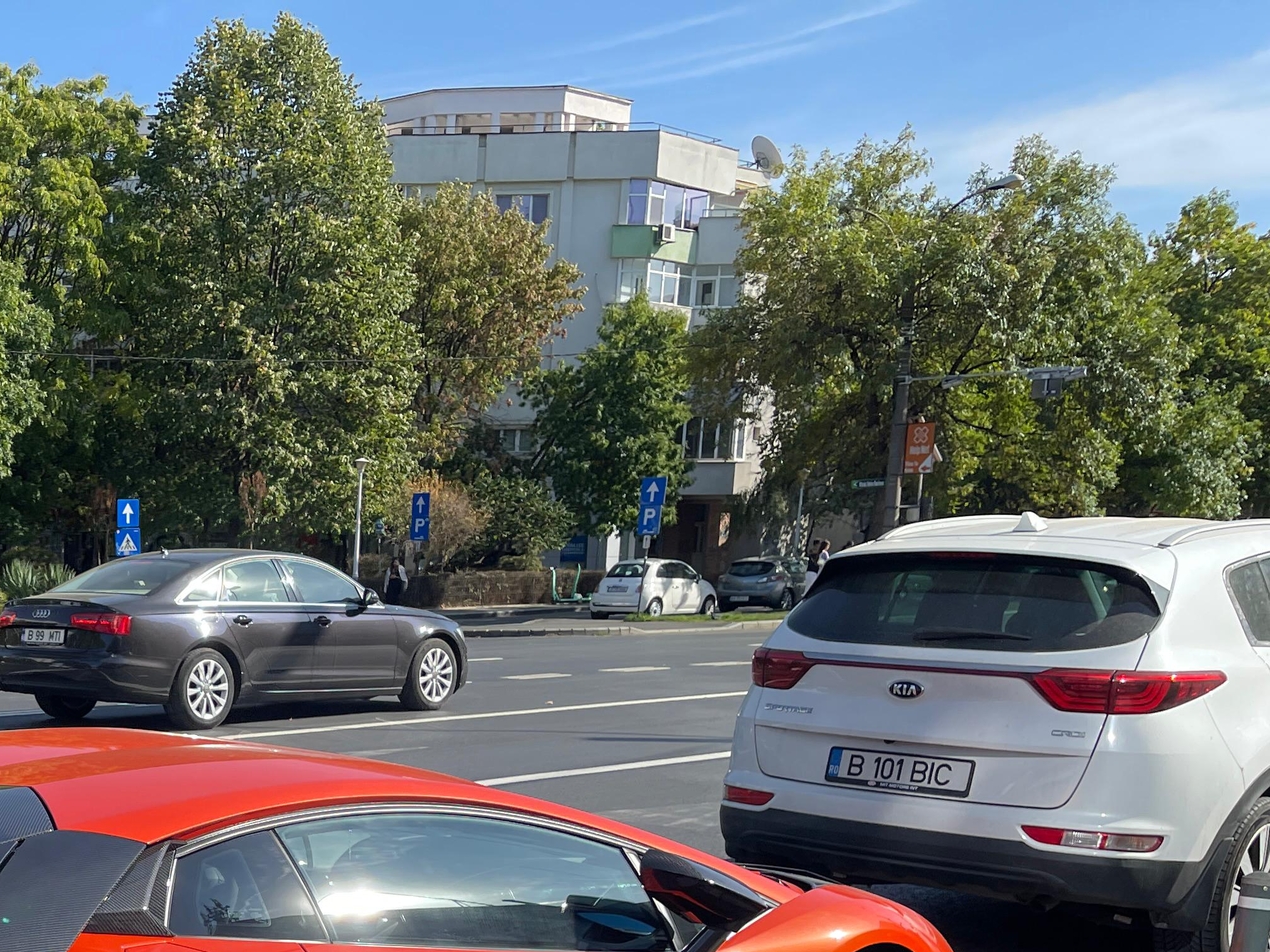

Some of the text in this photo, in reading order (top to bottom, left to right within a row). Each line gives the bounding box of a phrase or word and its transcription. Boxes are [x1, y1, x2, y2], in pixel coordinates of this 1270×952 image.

[643, 508, 656, 526] P
[414, 518, 425, 533] P
[27, 630, 34, 641] B
[35, 630, 45, 641] 99
[891, 683, 917, 696] KIA
[846, 754, 865, 777] B
[873, 756, 905, 781] 101
[909, 760, 953, 786] BIC
